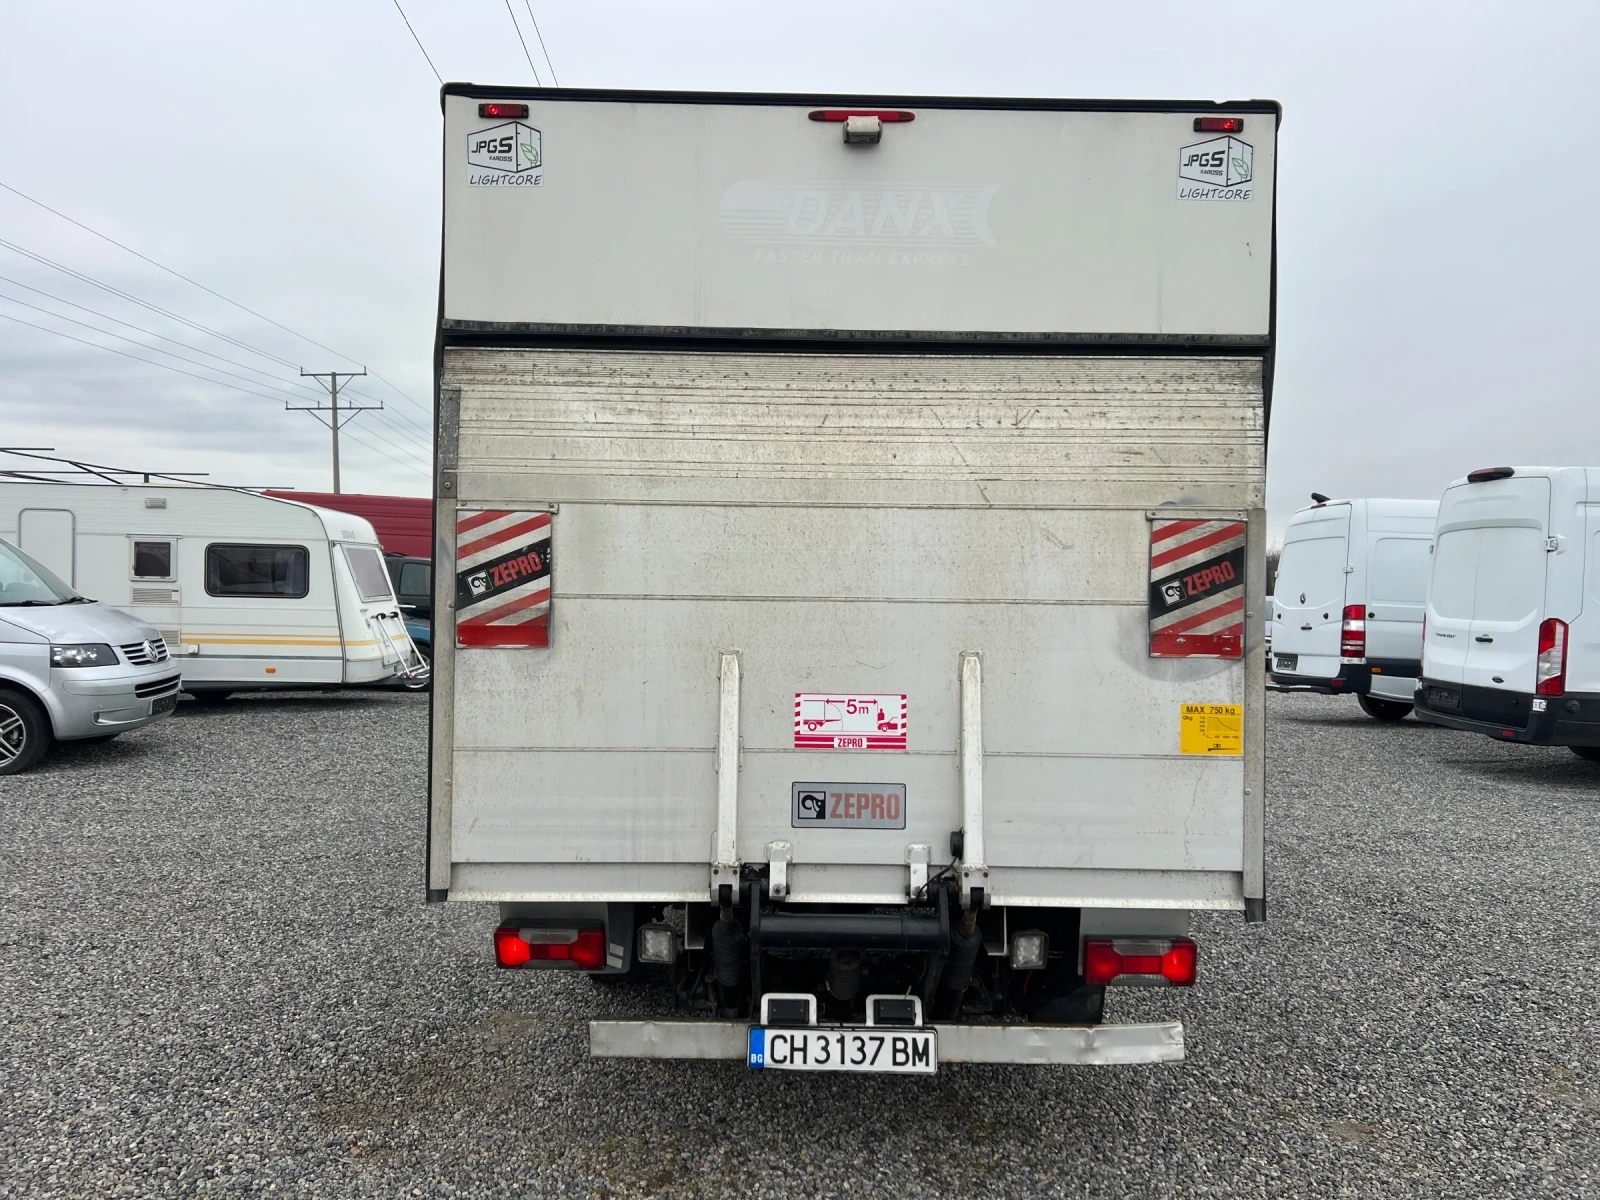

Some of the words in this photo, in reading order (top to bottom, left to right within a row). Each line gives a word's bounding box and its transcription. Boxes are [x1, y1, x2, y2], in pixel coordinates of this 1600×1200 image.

[471, 136, 514, 154] JPGS
[1183, 150, 1226, 167] JPGS
[469, 174, 543, 186] LIGHTCORE
[1180, 188, 1252, 200] LIGHTCORE
[783, 188, 969, 238] DANX
[754, 248, 822, 265] FASTER
[831, 251, 882, 265] THAN
[888, 252, 970, 268] EXPRESS
[489, 551, 542, 587] ZEPRO
[1183, 560, 1236, 596] ZEPRO
[1209, 706, 1223, 714] 750
[1225, 707, 1235, 715] kg
[837, 738, 863, 748] ZEPRO
[829, 792, 900, 820] ZEPRO
[750, 1053, 763, 1064] BG
